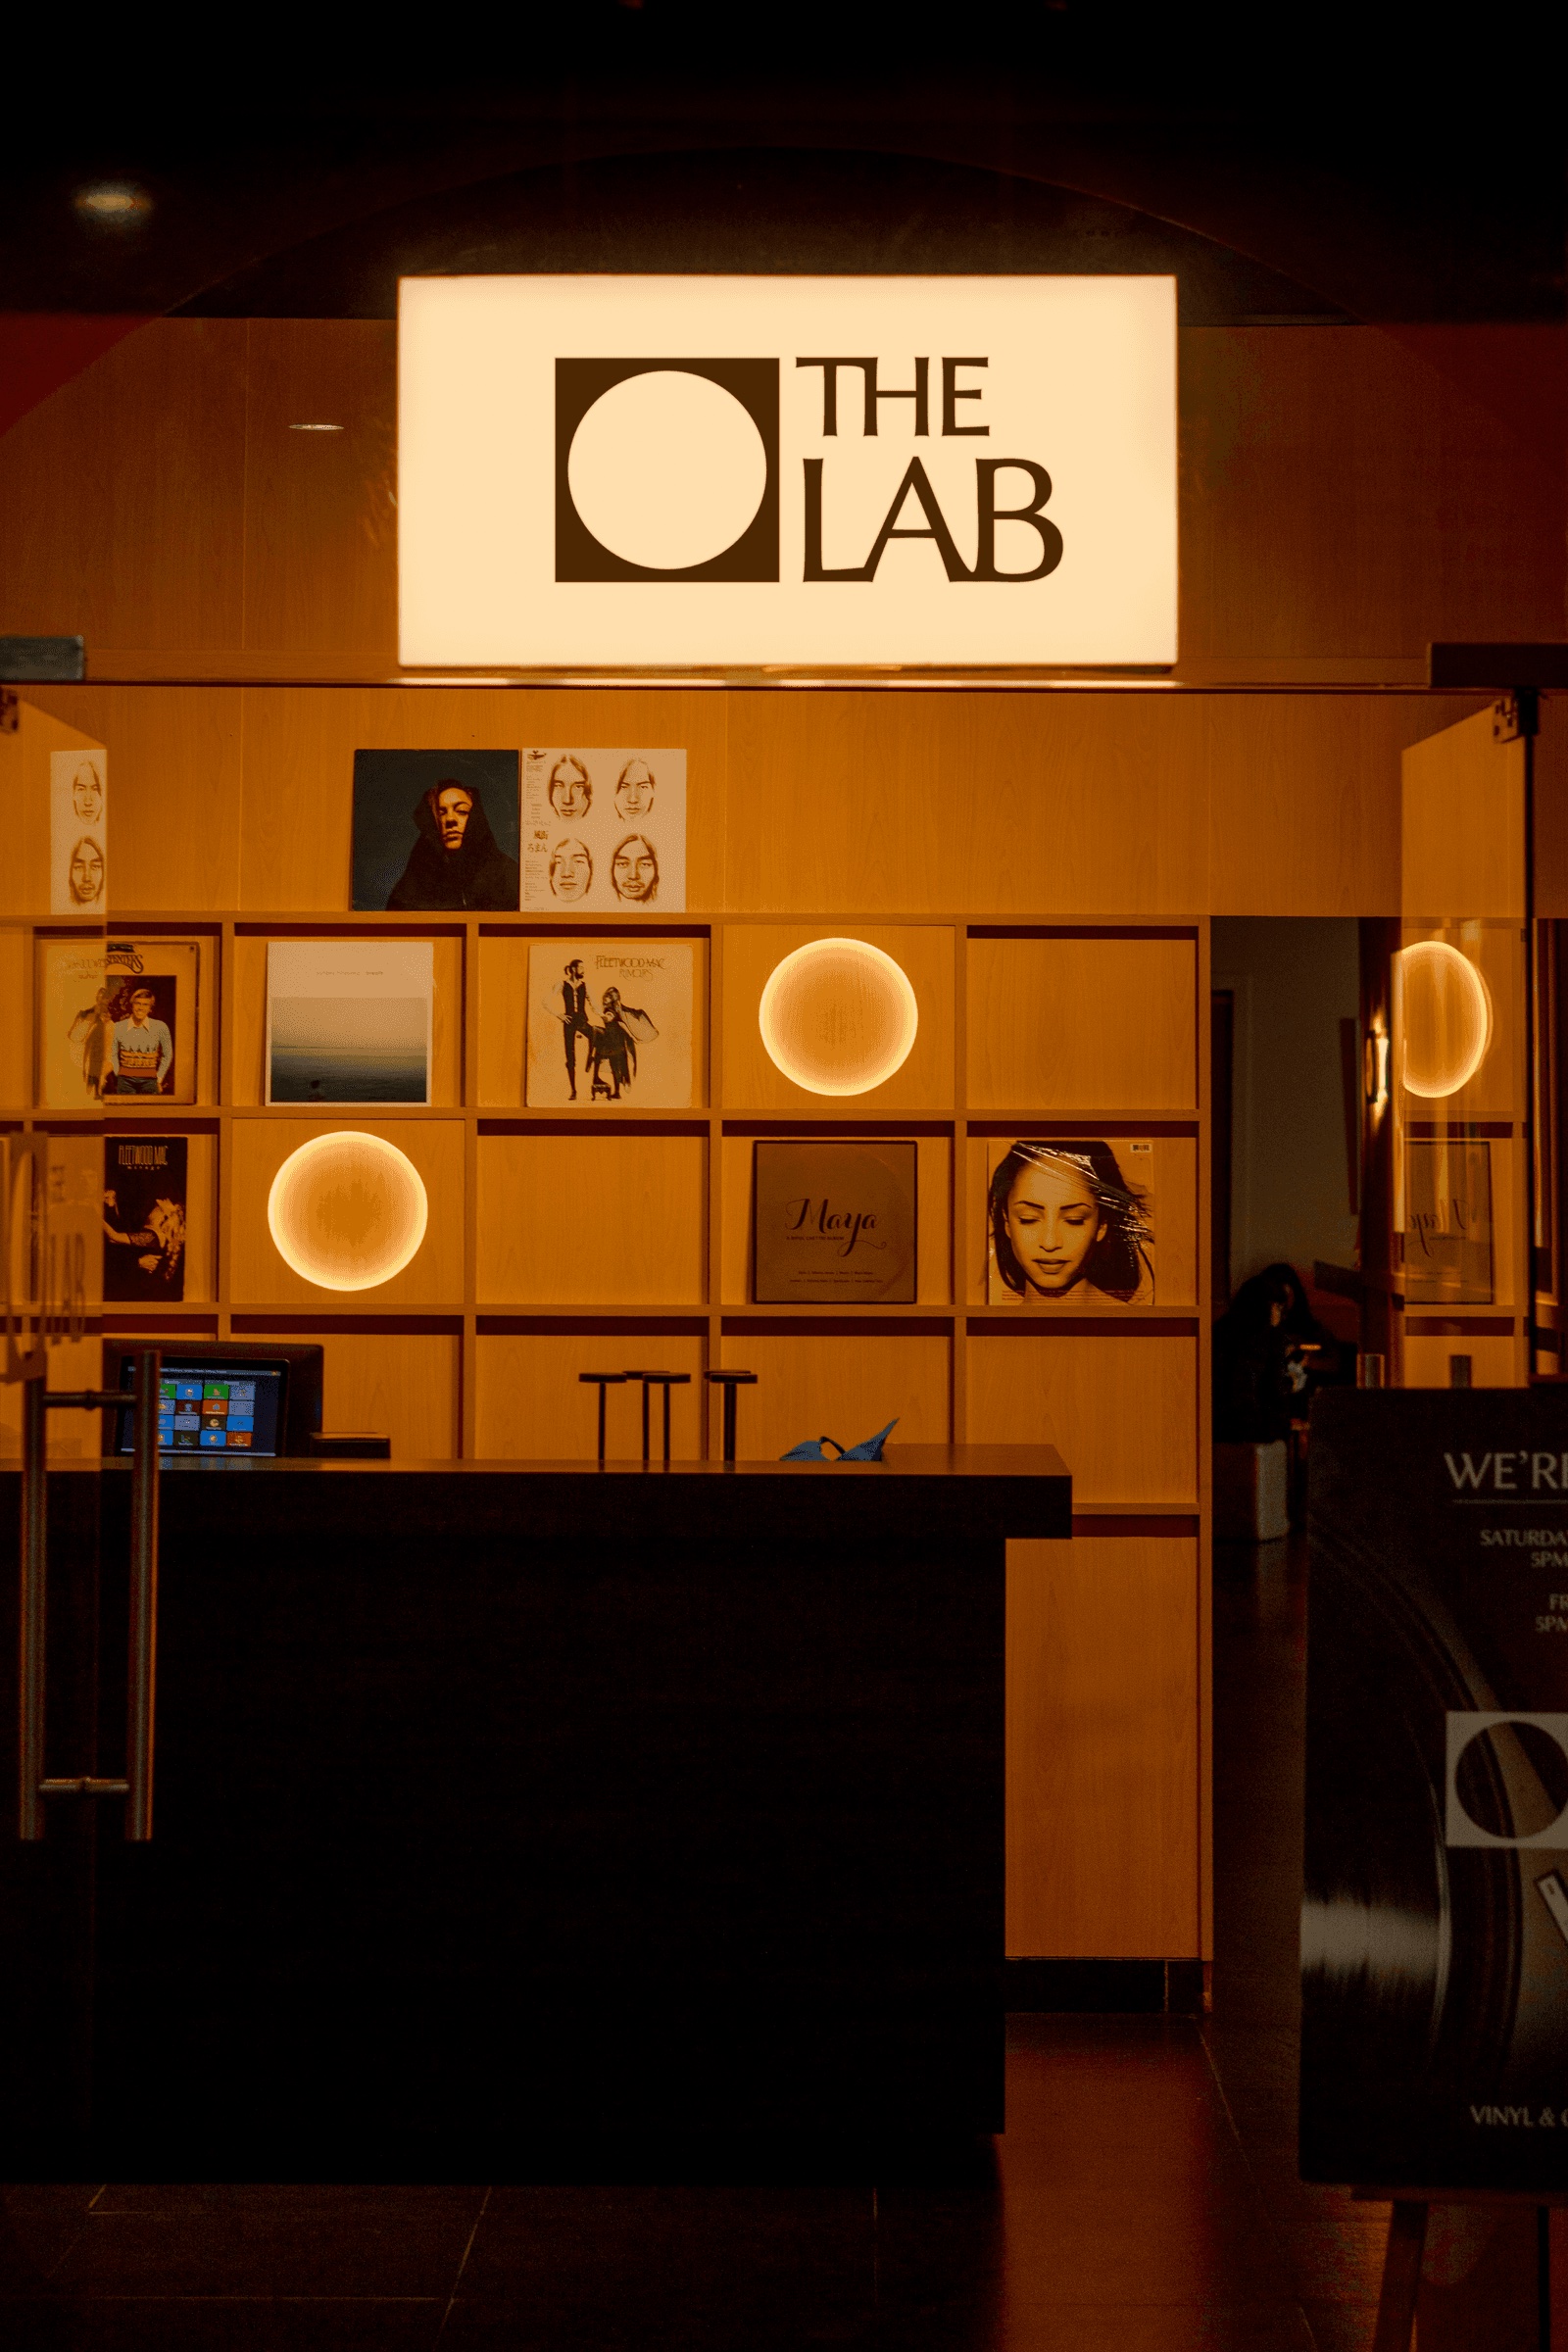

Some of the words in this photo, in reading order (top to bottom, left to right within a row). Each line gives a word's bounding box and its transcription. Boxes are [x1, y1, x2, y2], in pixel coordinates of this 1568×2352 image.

[796, 357, 990, 437] THE
[803, 456, 1064, 583] LAB
[595, 956, 645, 969] FLEETWOOD
[785, 1198, 887, 1258] Maya
[1479, 1528, 1568, 1547] SATURDA
[1469, 2104, 1534, 2128] VINYL
[1539, 2105, 1556, 2128] &
